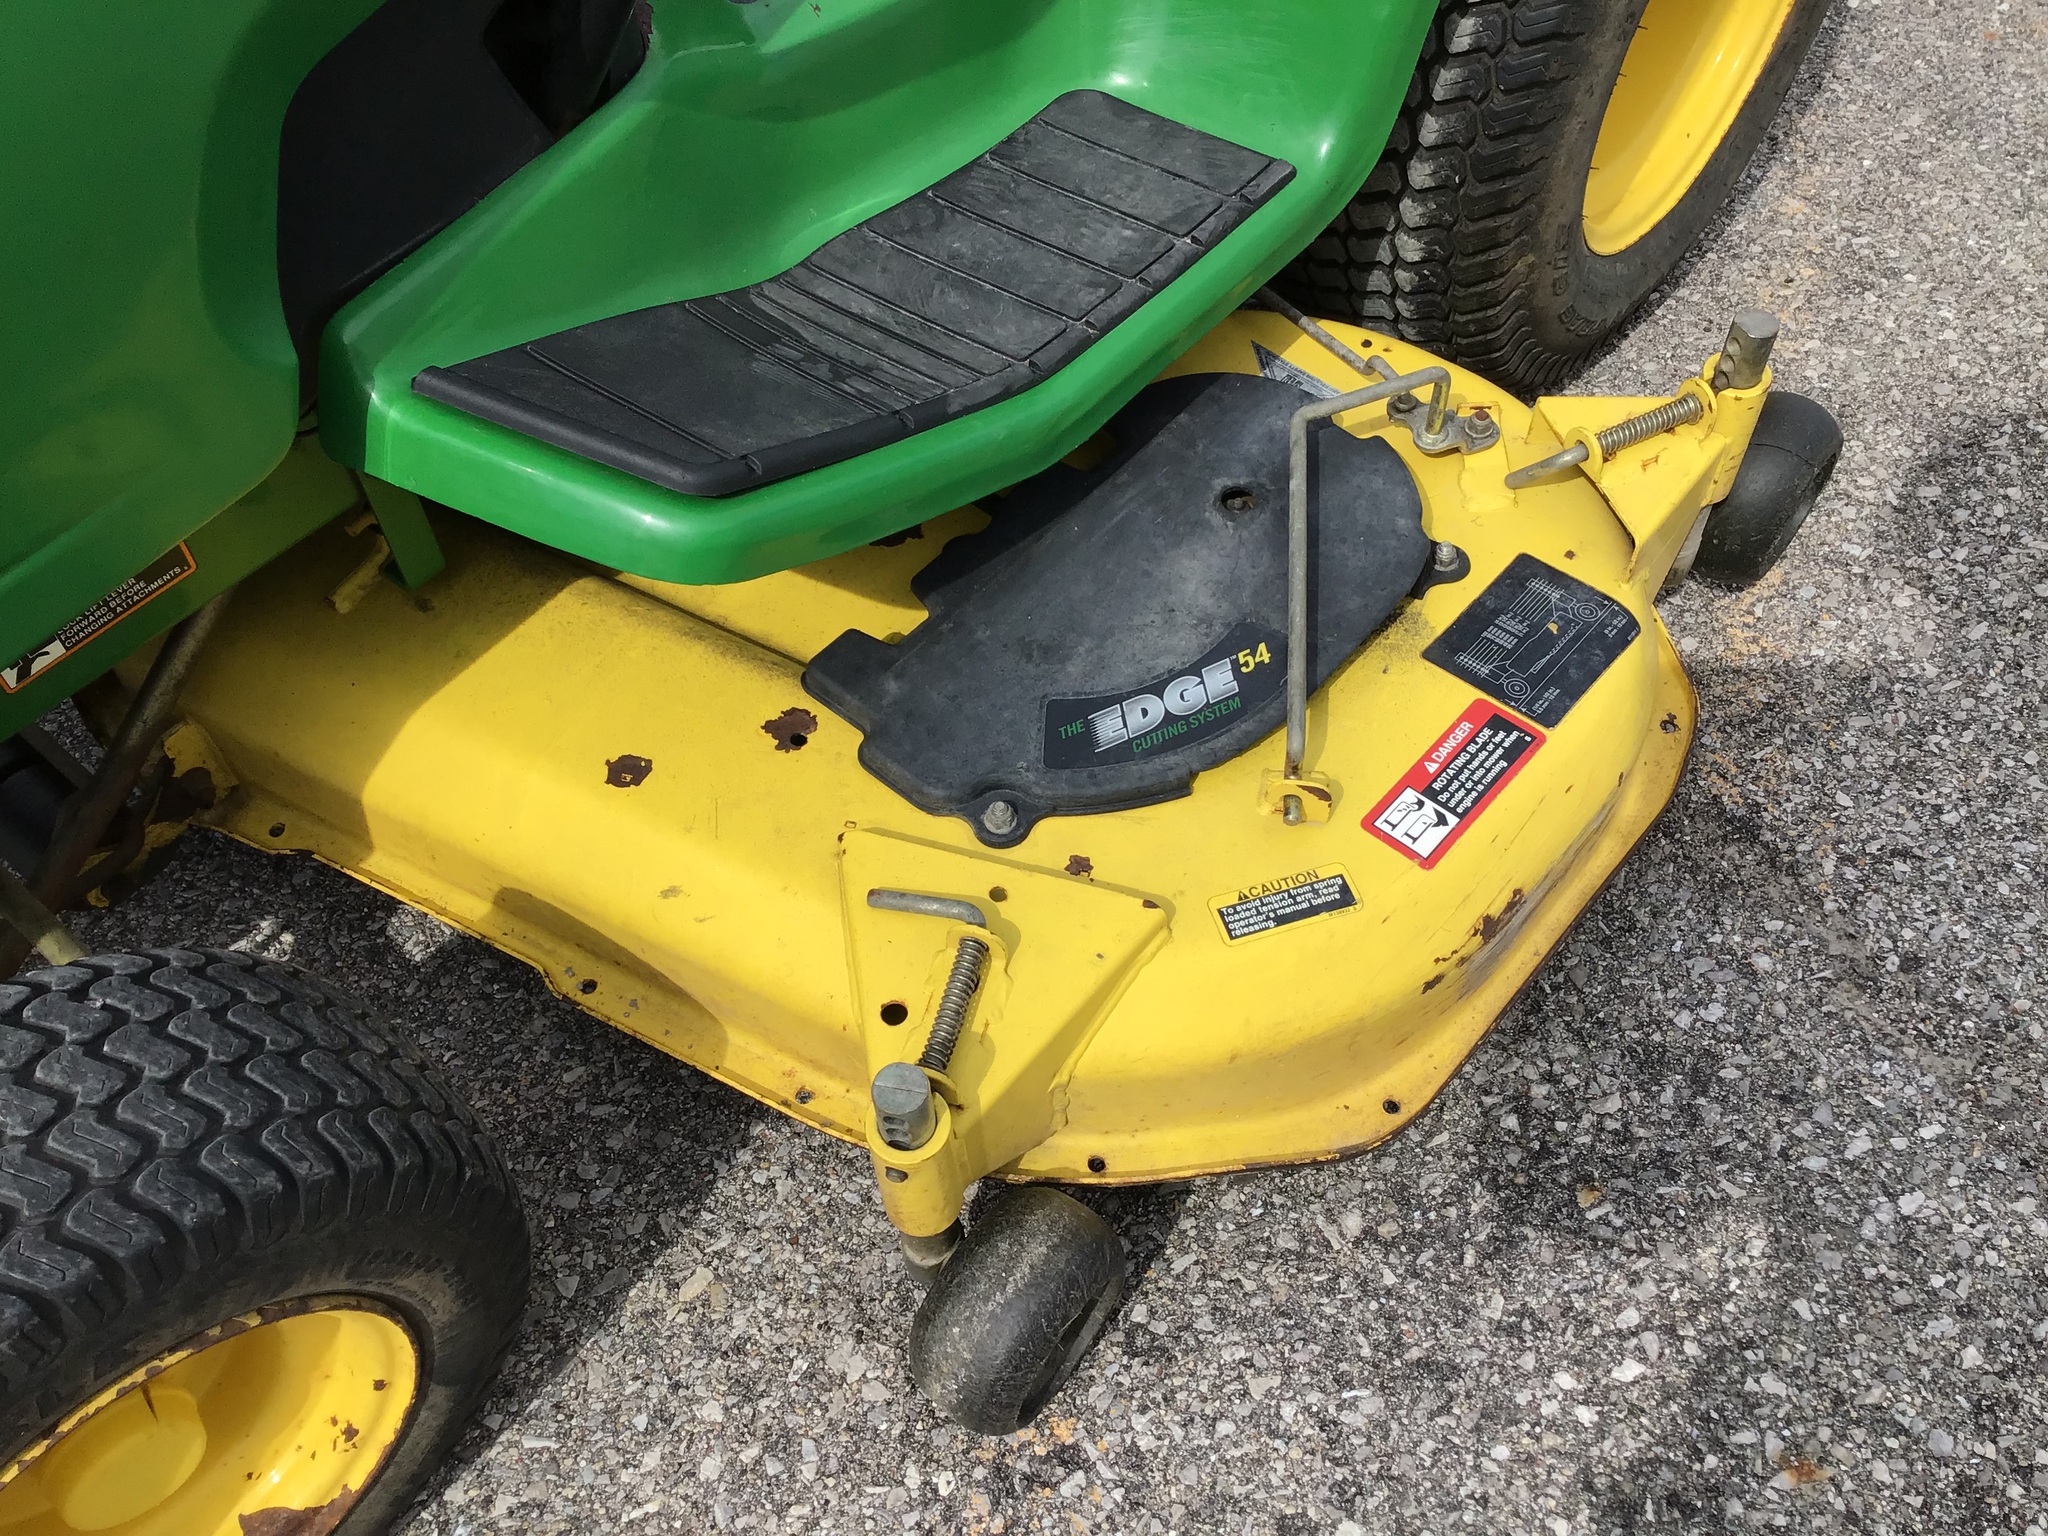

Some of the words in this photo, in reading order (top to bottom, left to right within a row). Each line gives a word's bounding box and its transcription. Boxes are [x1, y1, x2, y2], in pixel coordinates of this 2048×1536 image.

[60, 606, 108, 641] FORWARD
[109, 580, 147, 608] BEFORE
[65, 611, 114, 647] CHANGING
[116, 566, 181, 613] ATTACHMENTS
[105, 577, 136, 601] LEVER
[1058, 719, 1086, 739] THE
[1087, 657, 1239, 753] EDGE
[1237, 641, 1271, 673] 54
[1132, 720, 1188, 753] CUTTING
[1189, 696, 1242, 728] SYSTEM
[1431, 721, 1474, 763] DANGER
[1431, 752, 1471, 791] ROTATING
[1466, 727, 1494, 753] BLADE
[1437, 791, 1451, 803] Do
[1448, 779, 1461, 793] not
[1458, 768, 1472, 783] put
[1467, 750, 1489, 770] hands
[1486, 742, 1495, 751] or
[1491, 730, 1507, 744] feet
[1447, 787, 1467, 808] under
[1464, 779, 1474, 789] or
[1470, 767, 1486, 781] into
[1483, 746, 1505, 769] mower
[1501, 730, 1520, 748] when
[1455, 790, 1478, 813] engine
[1473, 783, 1485, 792] is
[1481, 759, 1508, 785] running
[1220, 907, 1234, 915] To
[1235, 899, 1261, 912] avoid
[1262, 892, 1288, 904] injury
[1290, 885, 1312, 896] from
[1313, 876, 1343, 889] spring
[1224, 908, 1257, 923] loaded
[1258, 898, 1294, 913] tension
[1295, 892, 1317, 902] arm,
[1318, 885, 1340, 896] read
[1248, 869, 1320, 898] CAUTION
[1228, 911, 1275, 930] operator's
[1276, 900, 1310, 916] manual
[1310, 893, 1341, 906] before
[1231, 920, 1277, 937] releasing.
